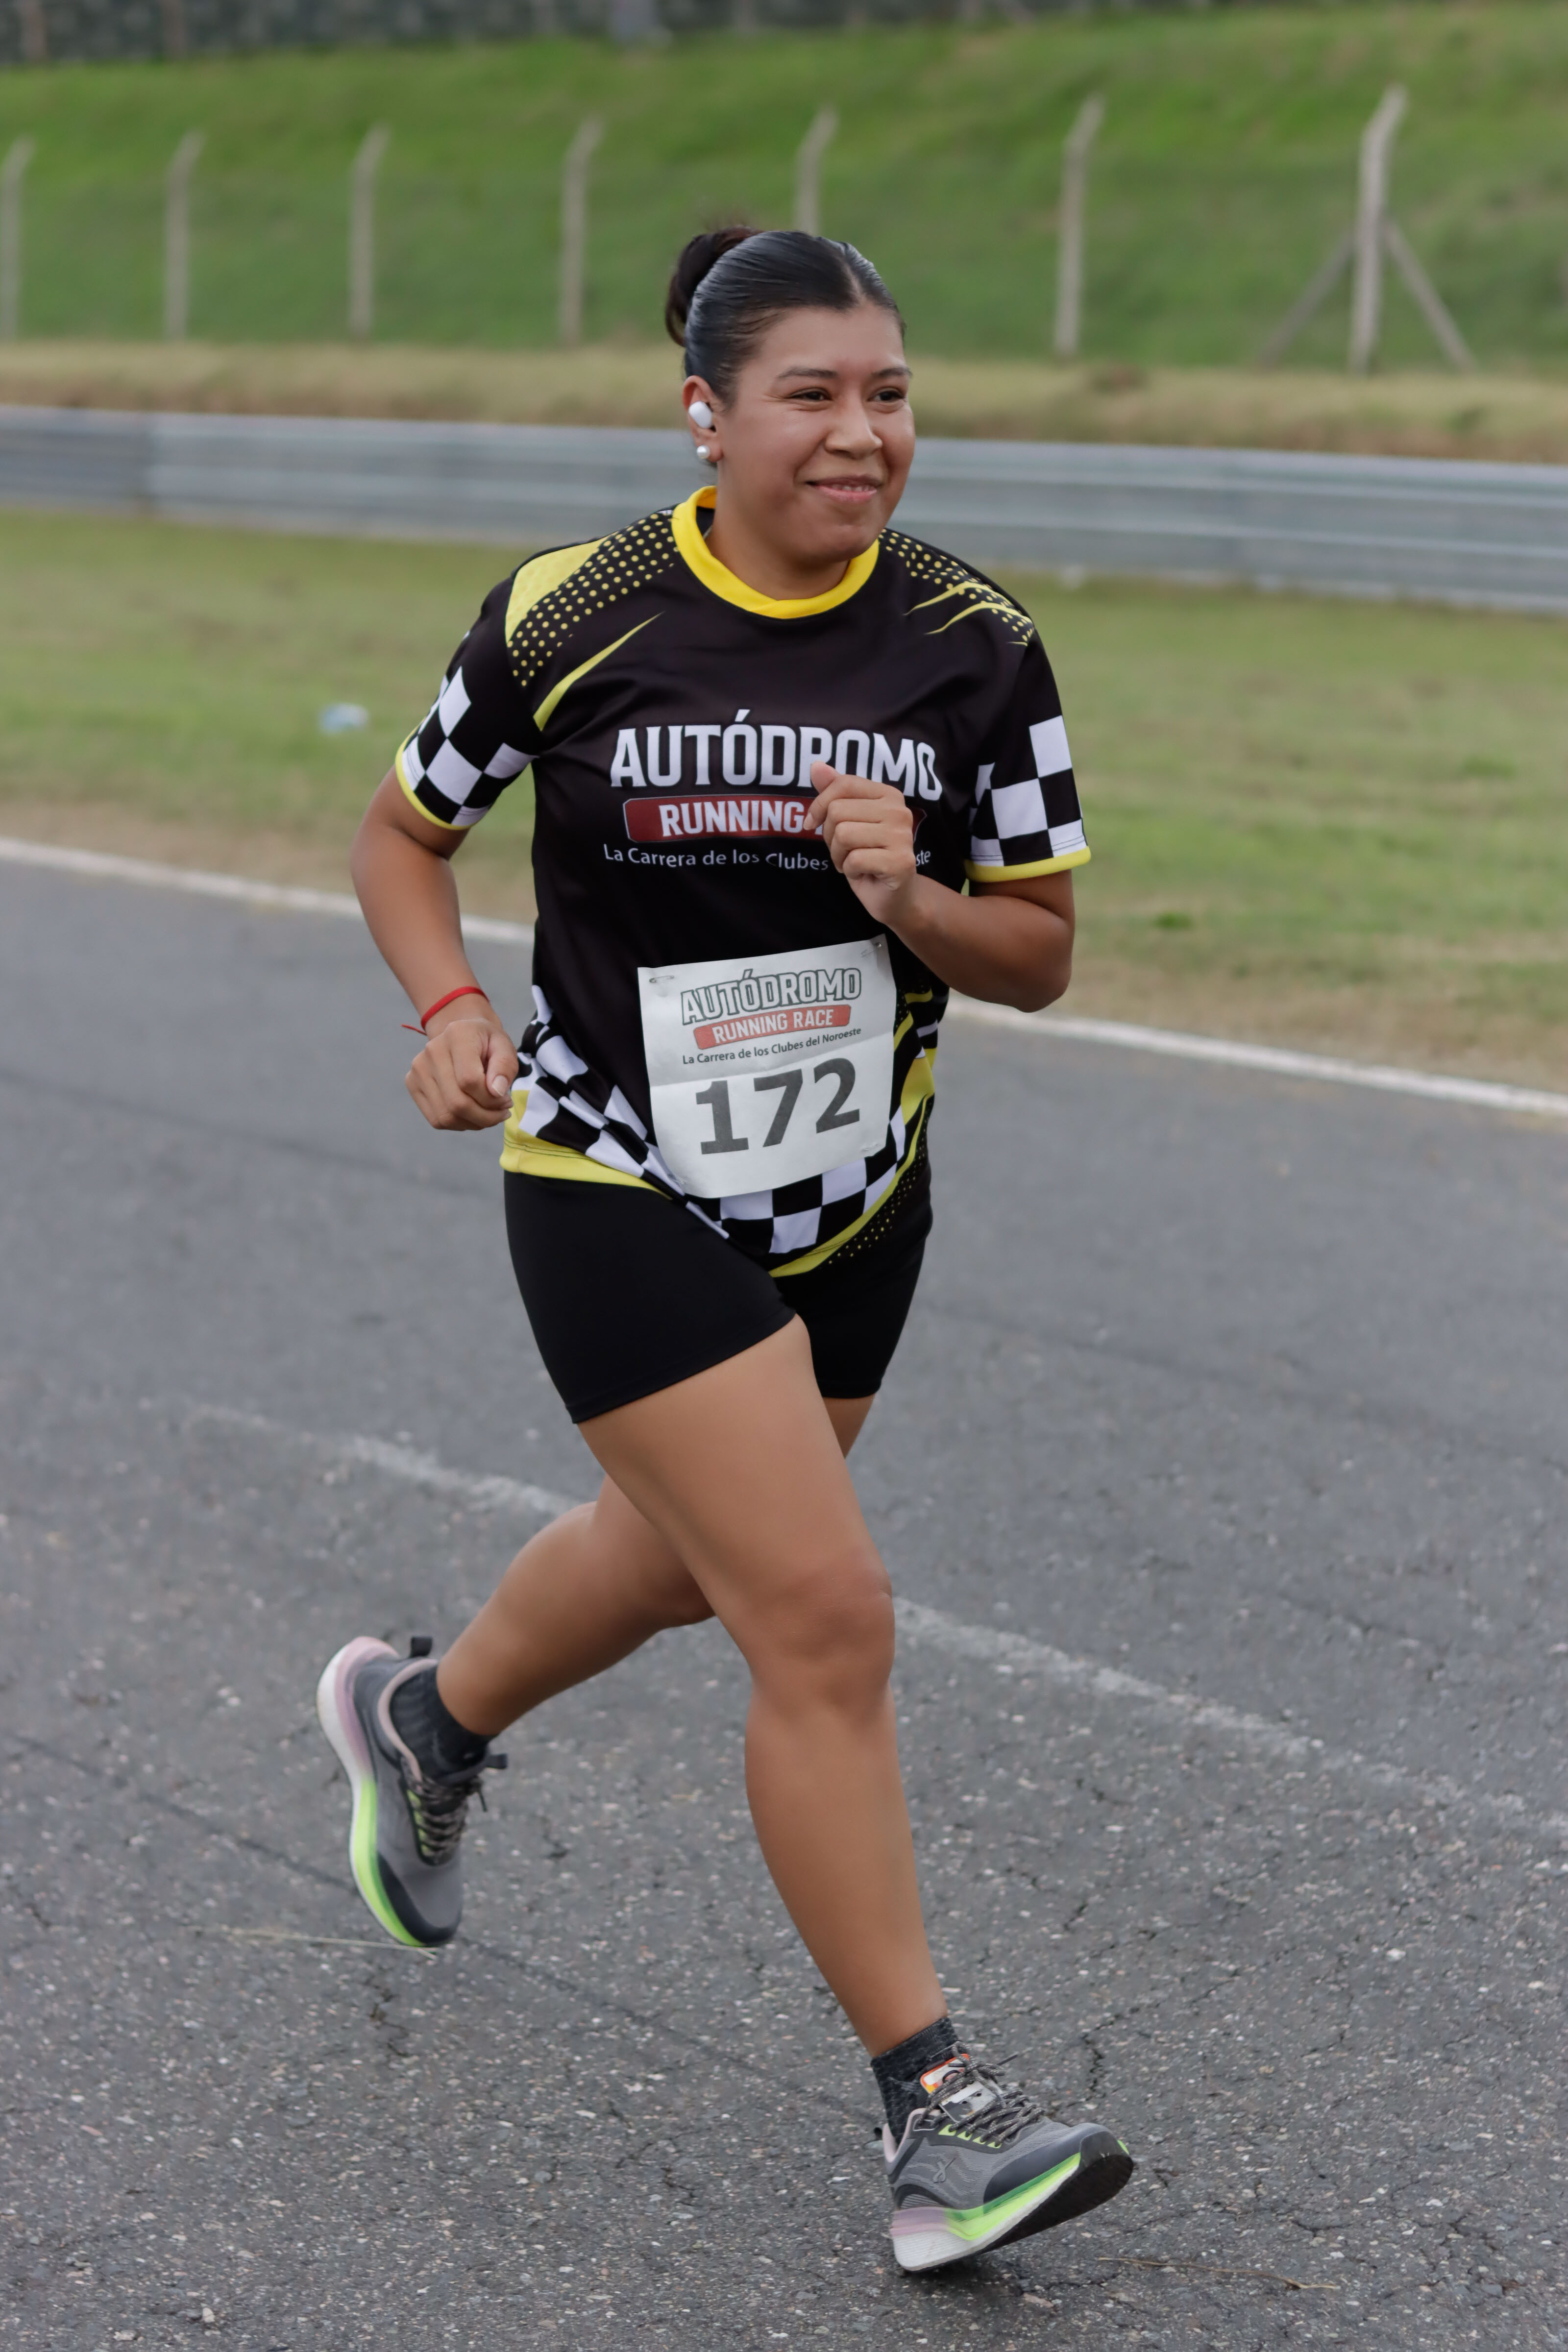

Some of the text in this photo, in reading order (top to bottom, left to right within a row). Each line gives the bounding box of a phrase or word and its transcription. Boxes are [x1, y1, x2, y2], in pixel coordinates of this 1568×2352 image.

[610, 709, 942, 801] AUTÓDROMO
[658, 800, 805, 837] RUNNING
[603, 843, 829, 871] La Carrera de los Clubes
[680, 968, 862, 1026] AUTÓDROMO
[711, 1009, 834, 1044] RUNNING RACE
[683, 1028, 861, 1064] La Carrera de los Clubes del Noroeste
[695, 1057, 860, 1155] 172
